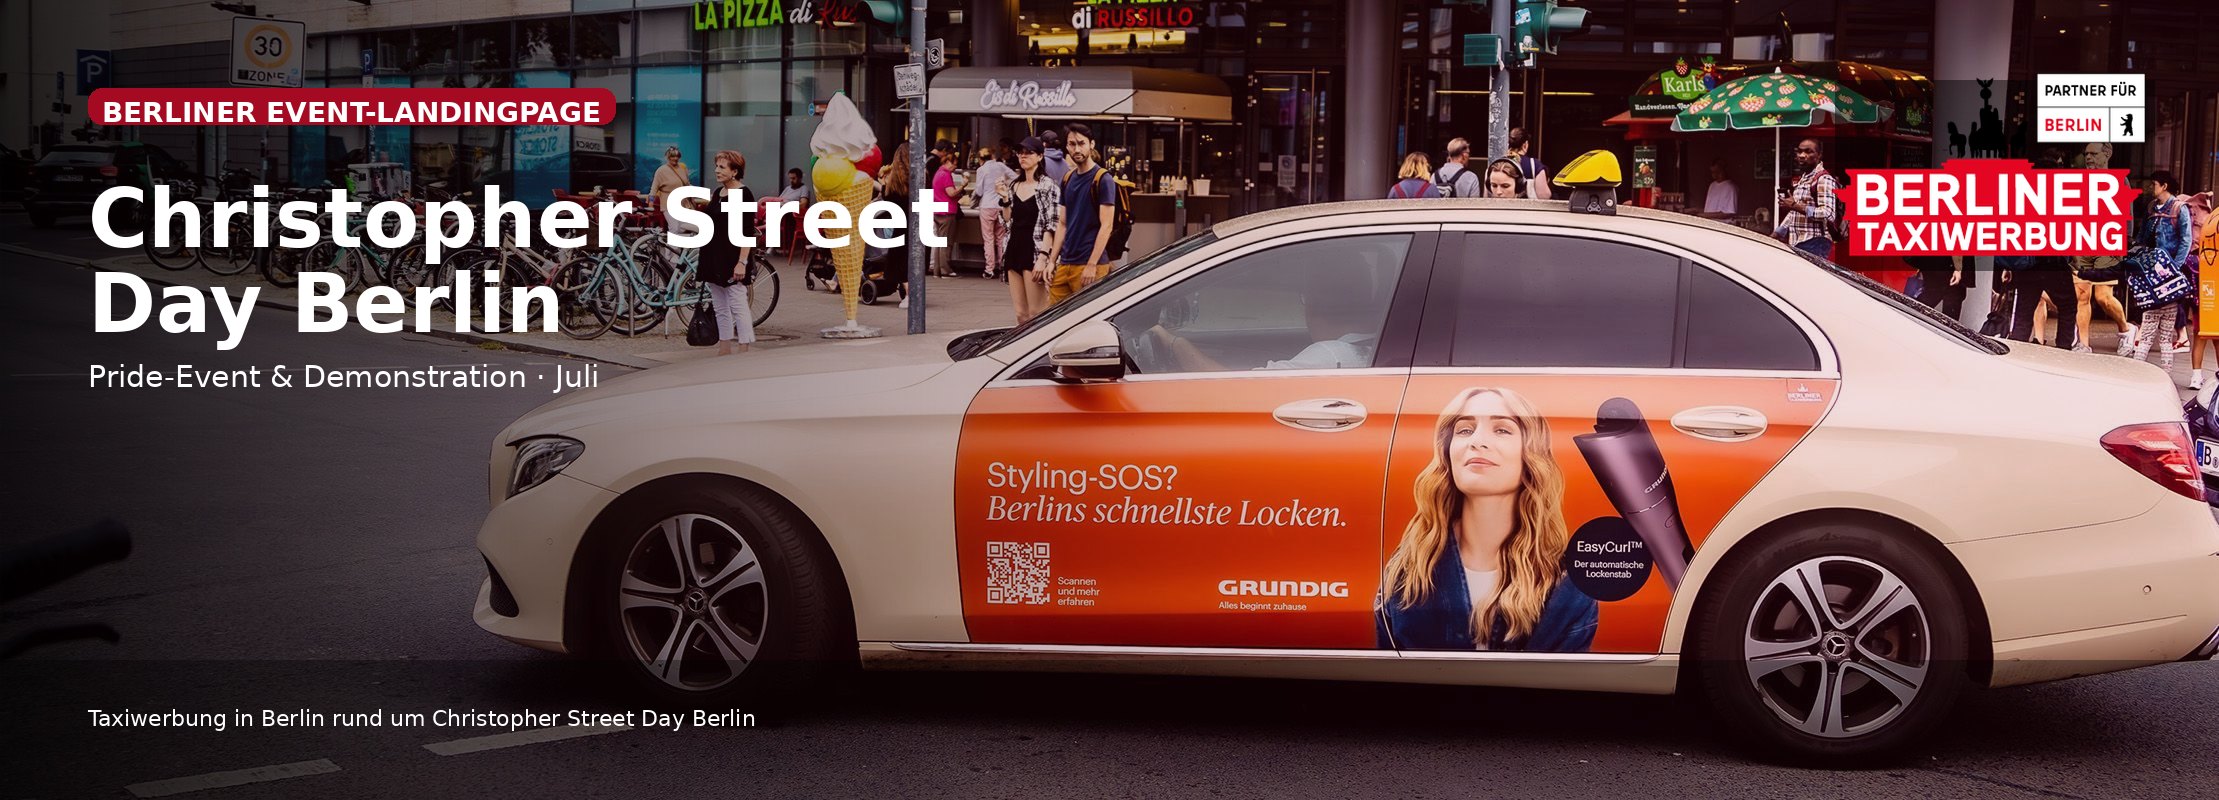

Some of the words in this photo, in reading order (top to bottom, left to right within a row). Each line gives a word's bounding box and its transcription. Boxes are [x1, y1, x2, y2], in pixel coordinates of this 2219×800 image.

[694, 0, 718, 30] LA
[723, 0, 784, 28] PIZZA
[789, 1, 814, 24] di
[1071, 6, 1092, 29] di
[1097, 7, 1193, 28] RUSSILLO
[254, 36, 282, 57] 30
[1664, 75, 1706, 92] Karls
[980, 79, 1003, 110] Eis
[1003, 80, 1019, 105] di
[1019, 80, 1077, 110] Russillo
[987, 461, 1178, 495] Styling-SOS?
[987, 495, 1087, 523] Berlins
[1093, 496, 1232, 525] schnellste
[1237, 499, 1346, 527] Locken.
[1574, 560, 1588, 568] Der
[1590, 561, 1644, 569] automatische
[1057, 576, 1097, 586] Scannen
[1586, 570, 1632, 578] Lockenstab
[1057, 586, 1075, 596] und
[1076, 587, 1100, 596] mehr
[1218, 580, 1349, 598] GRUNDIG
[1057, 597, 1095, 607] erfahren
[1219, 601, 1238, 610] Alles
[1240, 602, 1271, 611] beginnt
[1273, 602, 1307, 611] zuhause
